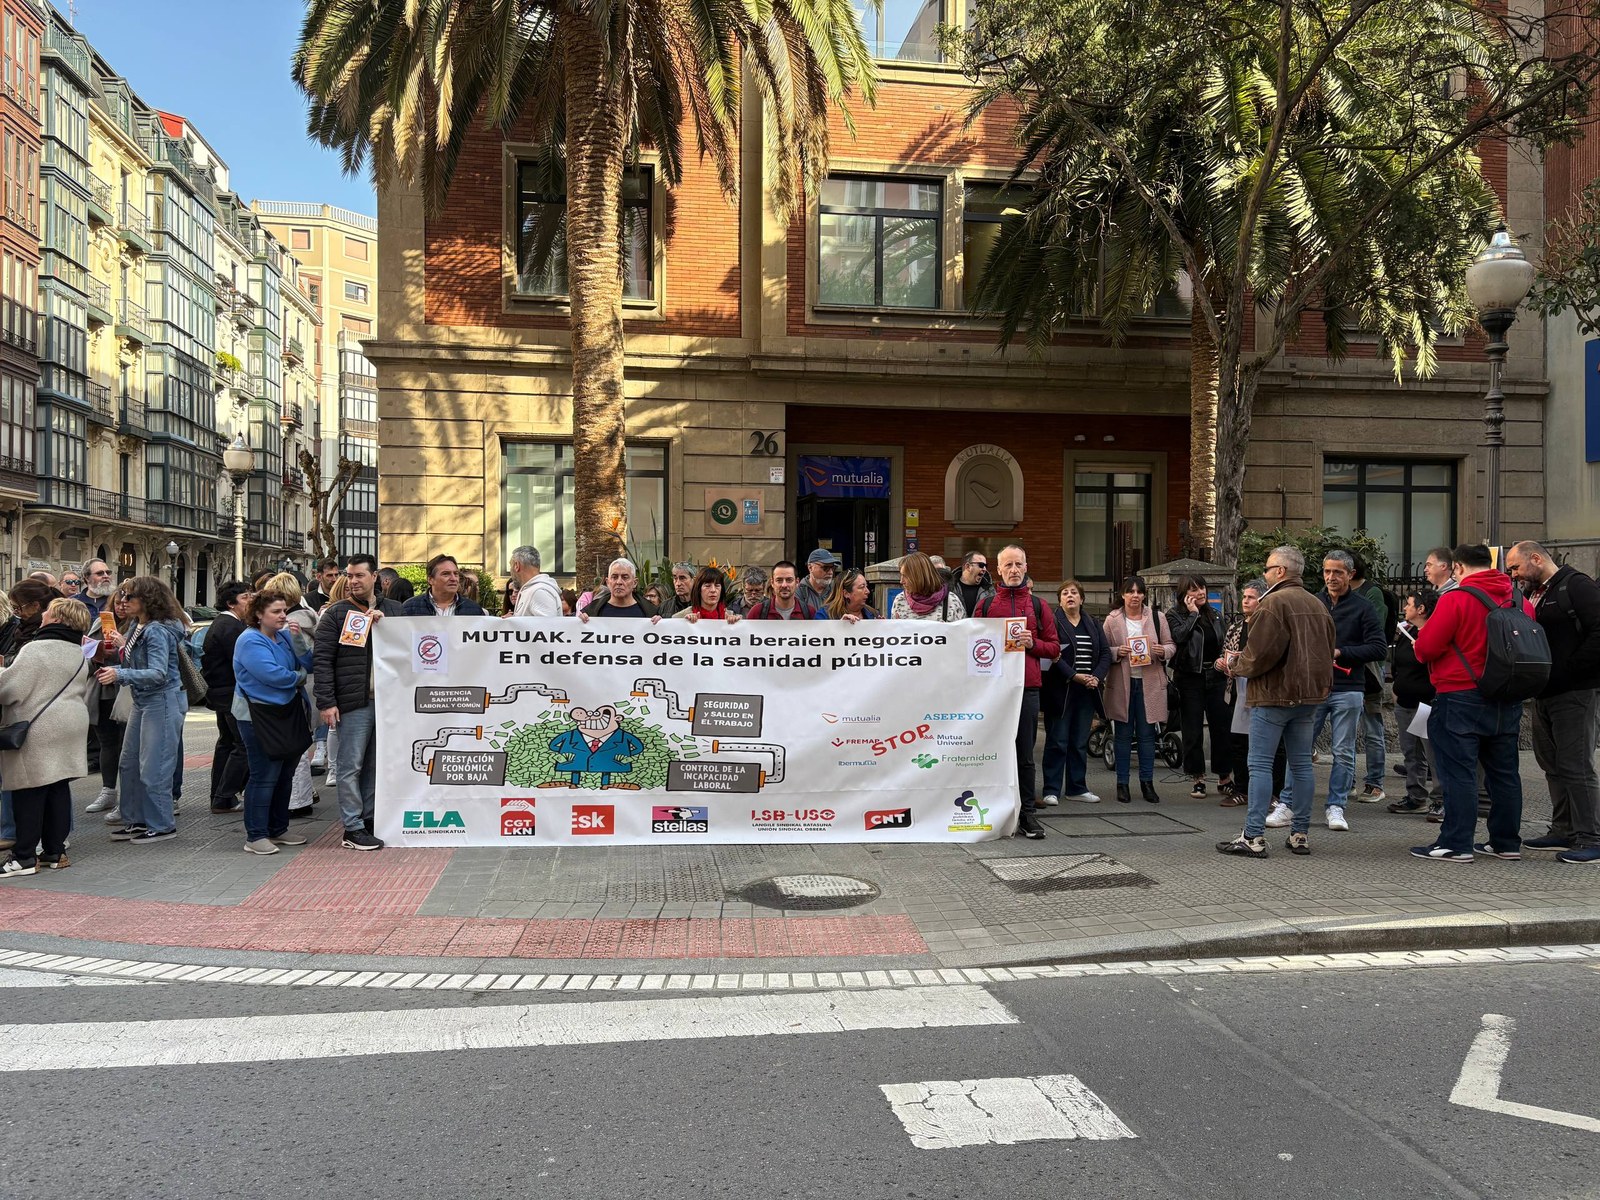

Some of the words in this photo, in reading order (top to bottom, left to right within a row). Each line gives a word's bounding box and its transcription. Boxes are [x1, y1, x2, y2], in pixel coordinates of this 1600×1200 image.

[750, 430, 779, 455] 26
[957, 444, 1013, 465] MUTUALIA
[832, 472, 883, 484] mutualia
[462, 631, 572, 643] MUTUAK.
[581, 632, 635, 644] Zure
[643, 632, 741, 646] Osasuna
[750, 634, 835, 646] beraien
[844, 633, 947, 648] negozioa
[499, 651, 530, 664] En
[540, 651, 643, 666] defensa
[652, 652, 684, 666] de
[693, 652, 714, 666] la
[723, 654, 822, 668] sanidad
[831, 653, 922, 670] pública
[704, 701, 749, 710] SEGURIDAD
[872, 724, 931, 756] STOP
[442, 753, 494, 762] PRESTACIÓN
[942, 753, 998, 762] Fraternidad
[442, 762, 493, 772] ECONÓMICA
[680, 764, 719, 772] CONTROL
[468, 773, 488, 782] BAJA
[684, 772, 738, 781] INCAPACIDAD
[693, 782, 731, 790] LABORAL
[403, 811, 465, 828] ELA
[752, 809, 835, 820] LSB-USO
[870, 814, 905, 824] CNT
